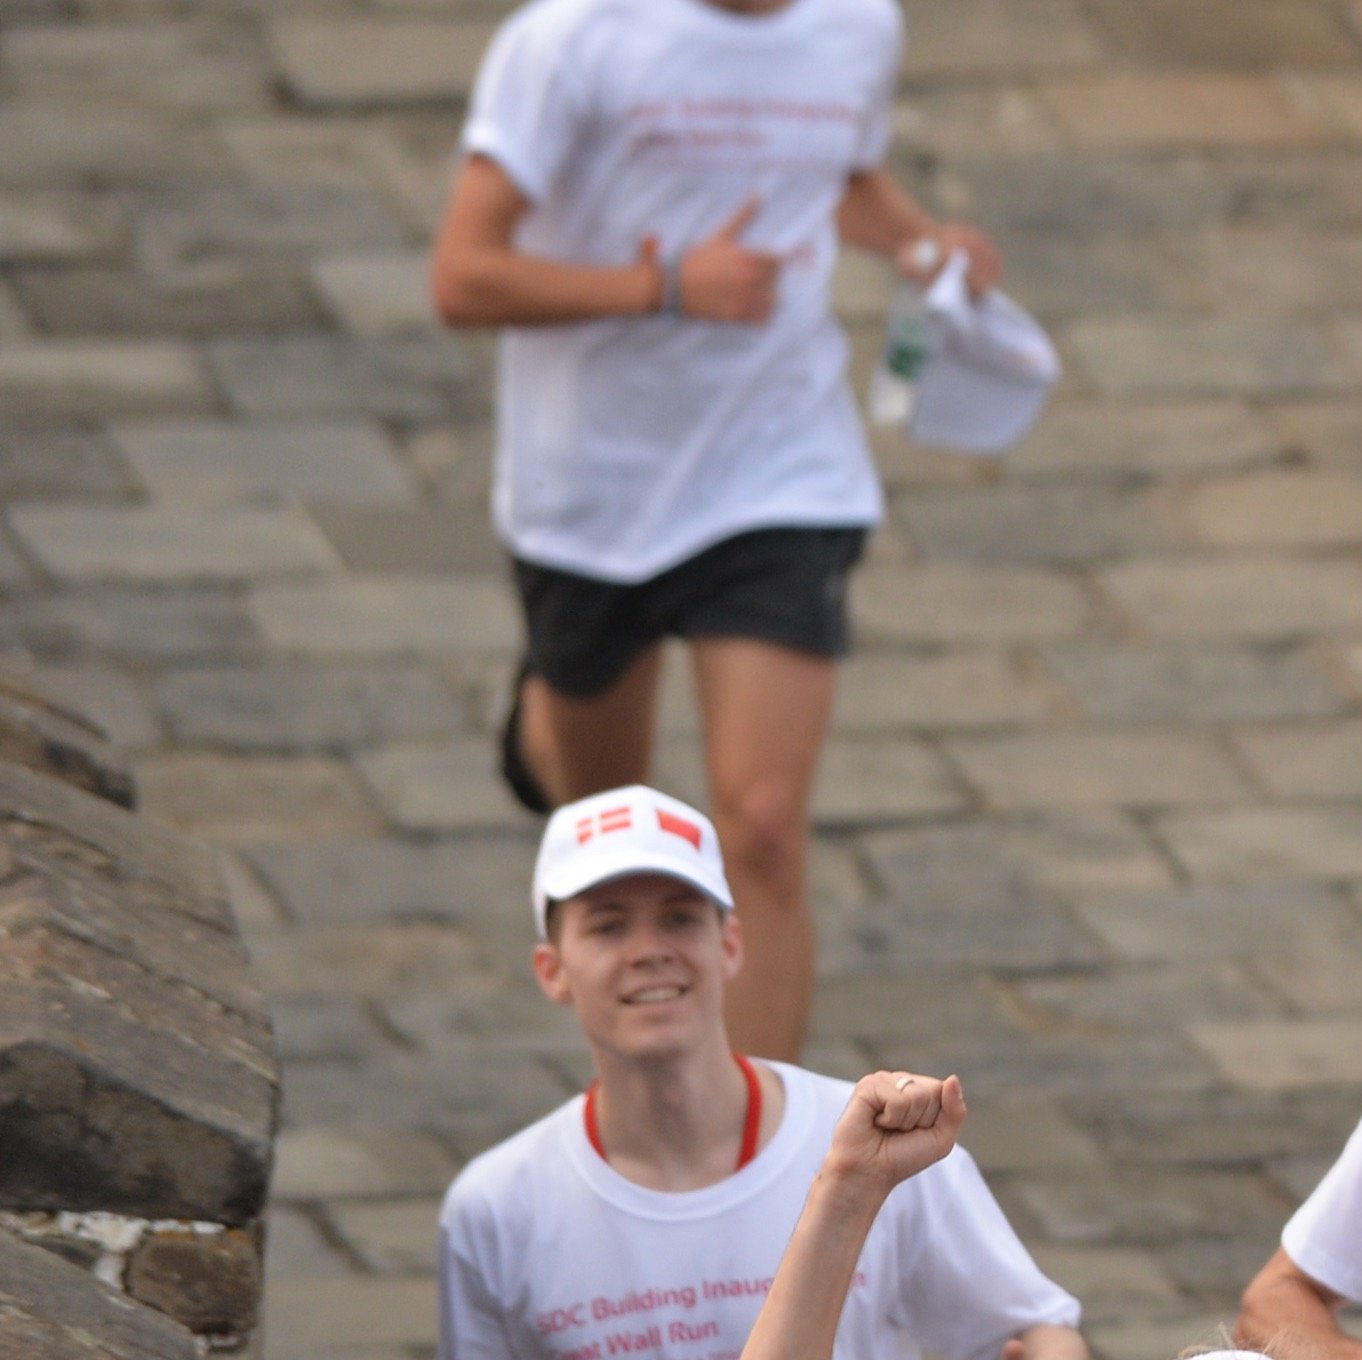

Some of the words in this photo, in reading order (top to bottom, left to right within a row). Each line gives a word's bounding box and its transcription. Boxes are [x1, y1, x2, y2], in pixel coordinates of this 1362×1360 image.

[590, 1286, 697, 1322] Building
[605, 1326, 663, 1356] Wall
[668, 1320, 720, 1344] Run
